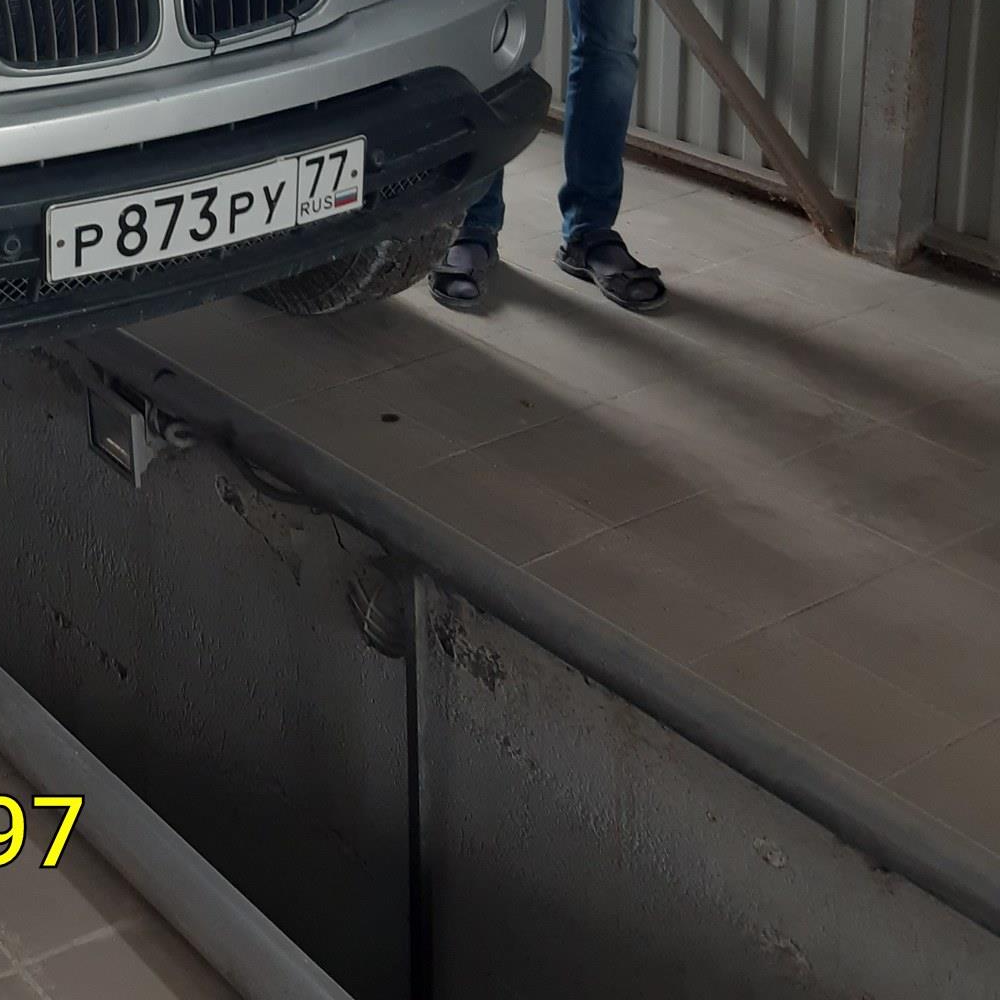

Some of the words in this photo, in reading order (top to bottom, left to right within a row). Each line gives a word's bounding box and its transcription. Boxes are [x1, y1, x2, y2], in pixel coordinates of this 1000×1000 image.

[74, 181, 286, 268] Р873РУ
[304, 148, 349, 199] 77
[300, 194, 334, 218] RUS
